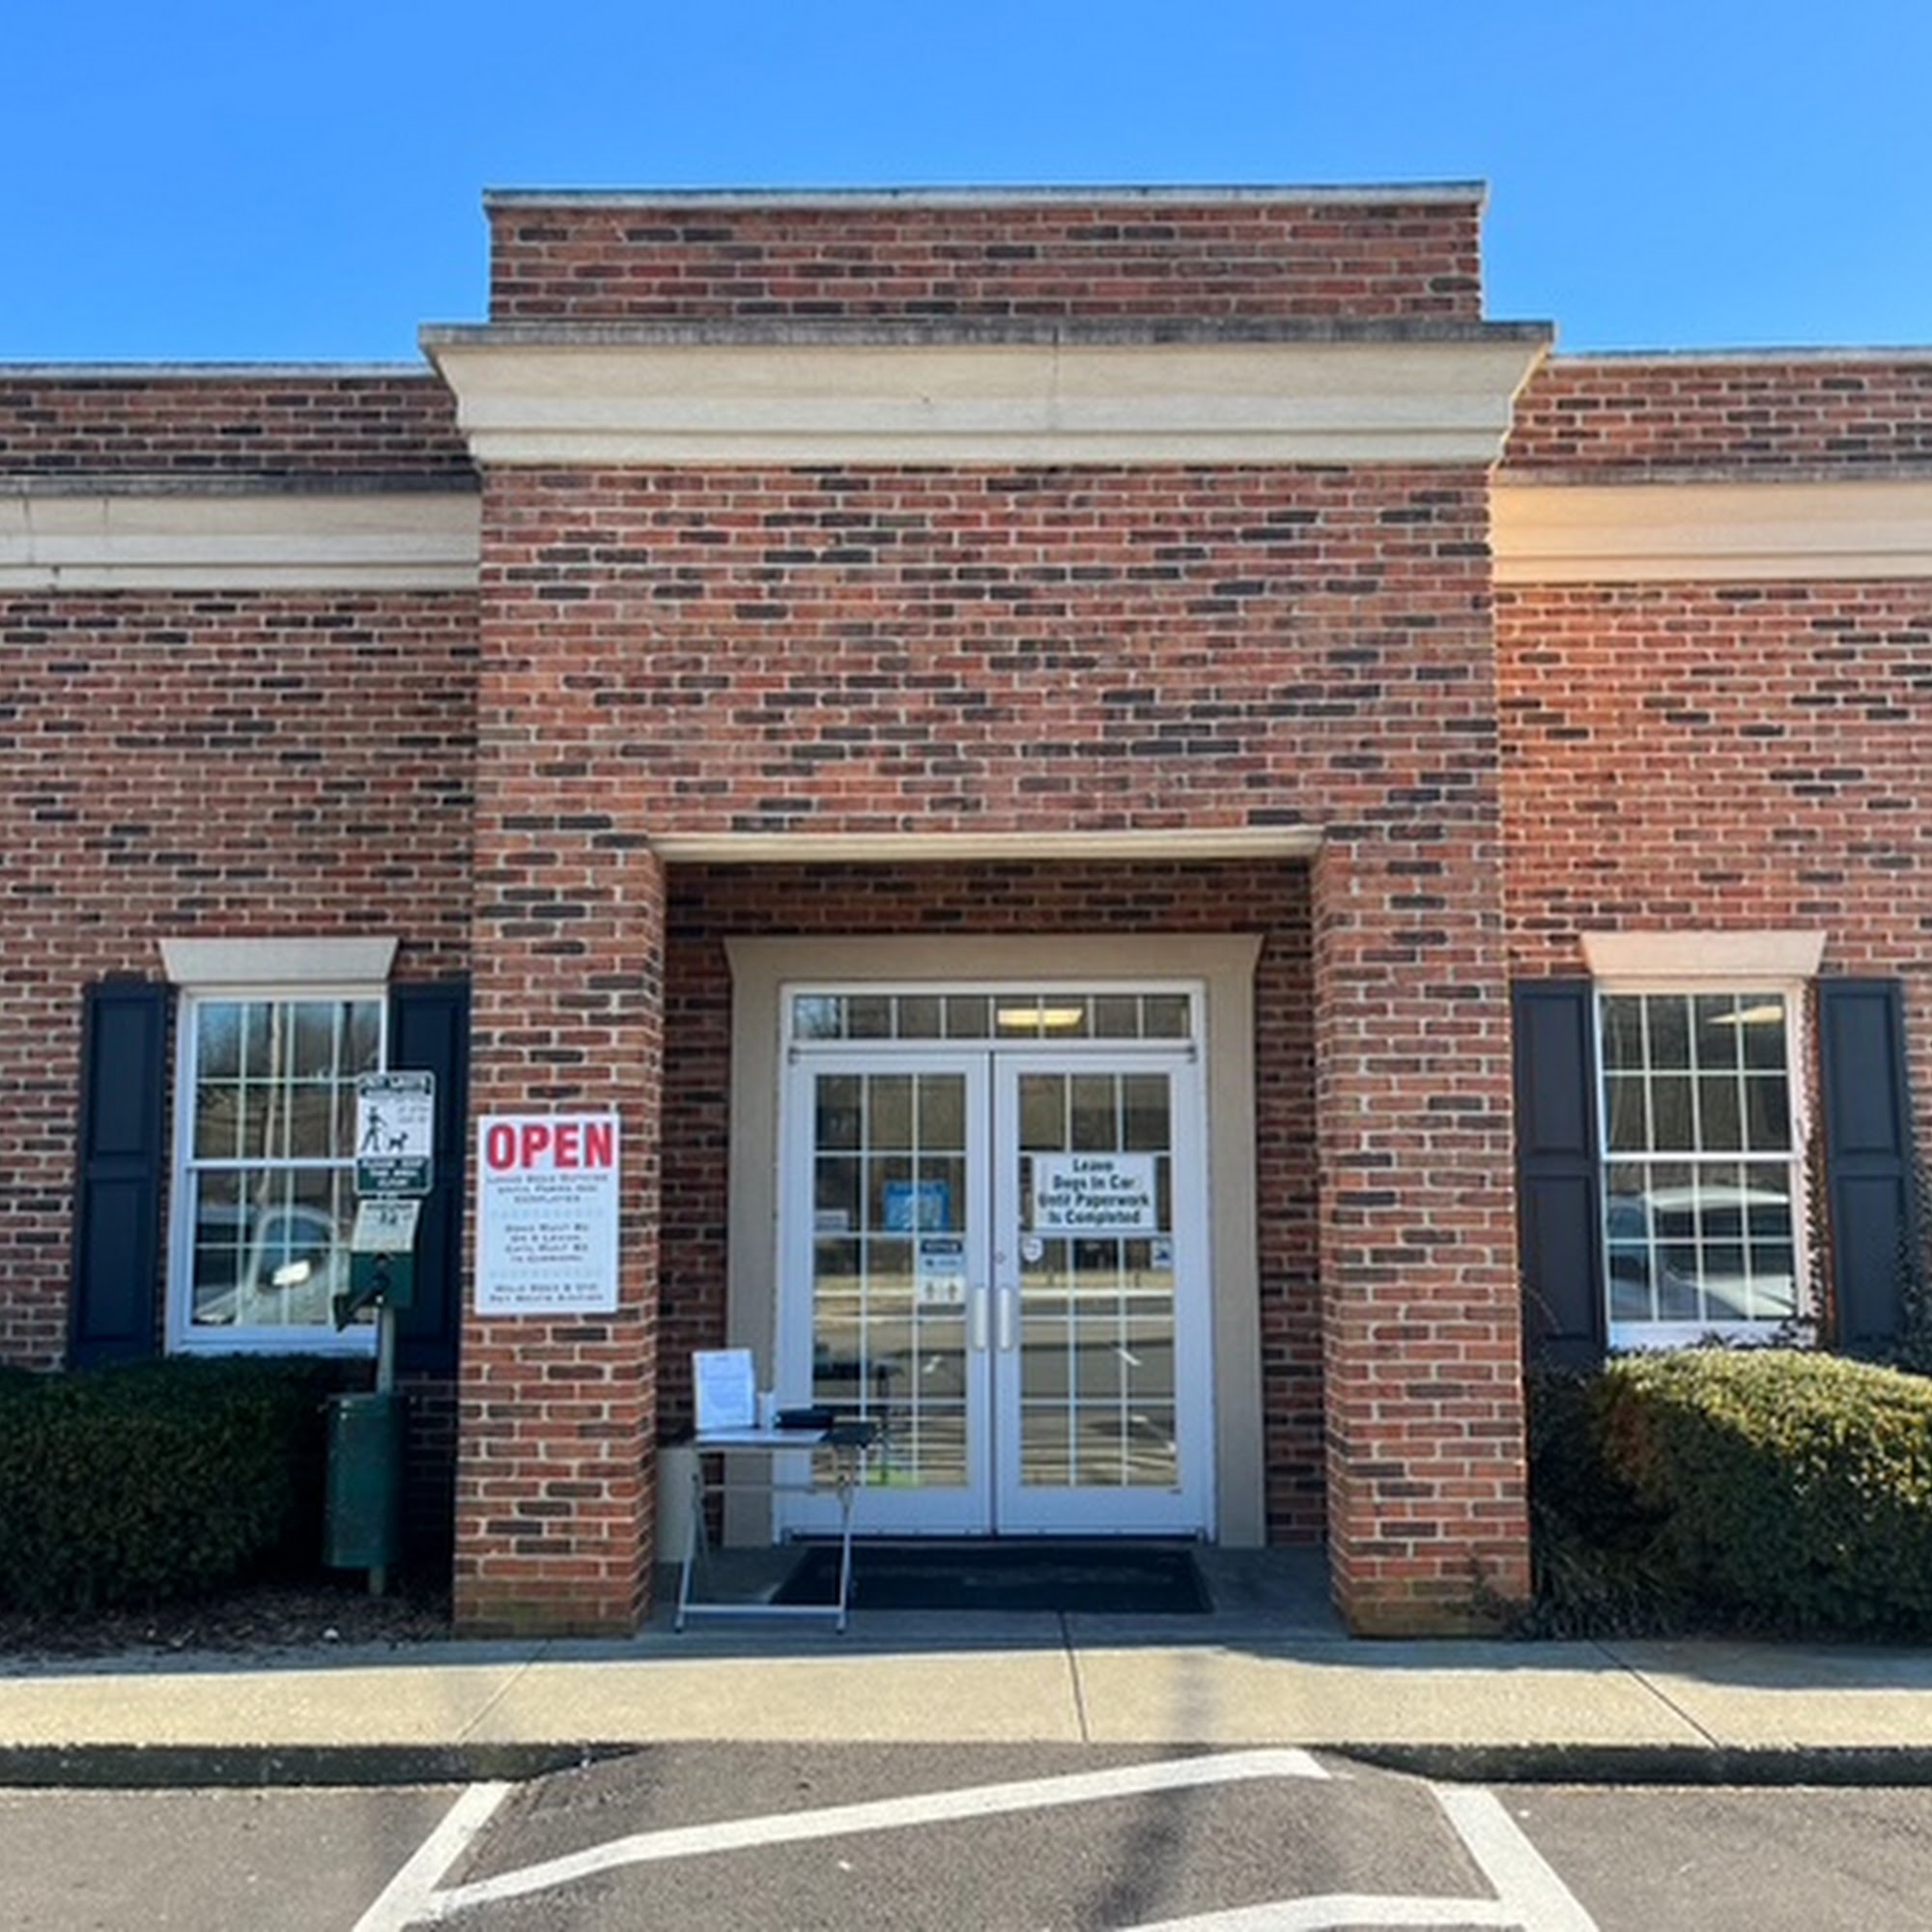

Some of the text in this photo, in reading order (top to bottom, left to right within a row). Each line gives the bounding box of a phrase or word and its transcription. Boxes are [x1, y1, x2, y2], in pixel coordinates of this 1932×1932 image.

[487, 1122, 612, 1170] OPEN
[1072, 1158, 1114, 1173] Leave
[1053, 1175, 1134, 1192] Dogs In Car
[1038, 1193, 1149, 1208] Until Paperwork
[1065, 1209, 1141, 1226] Completed
